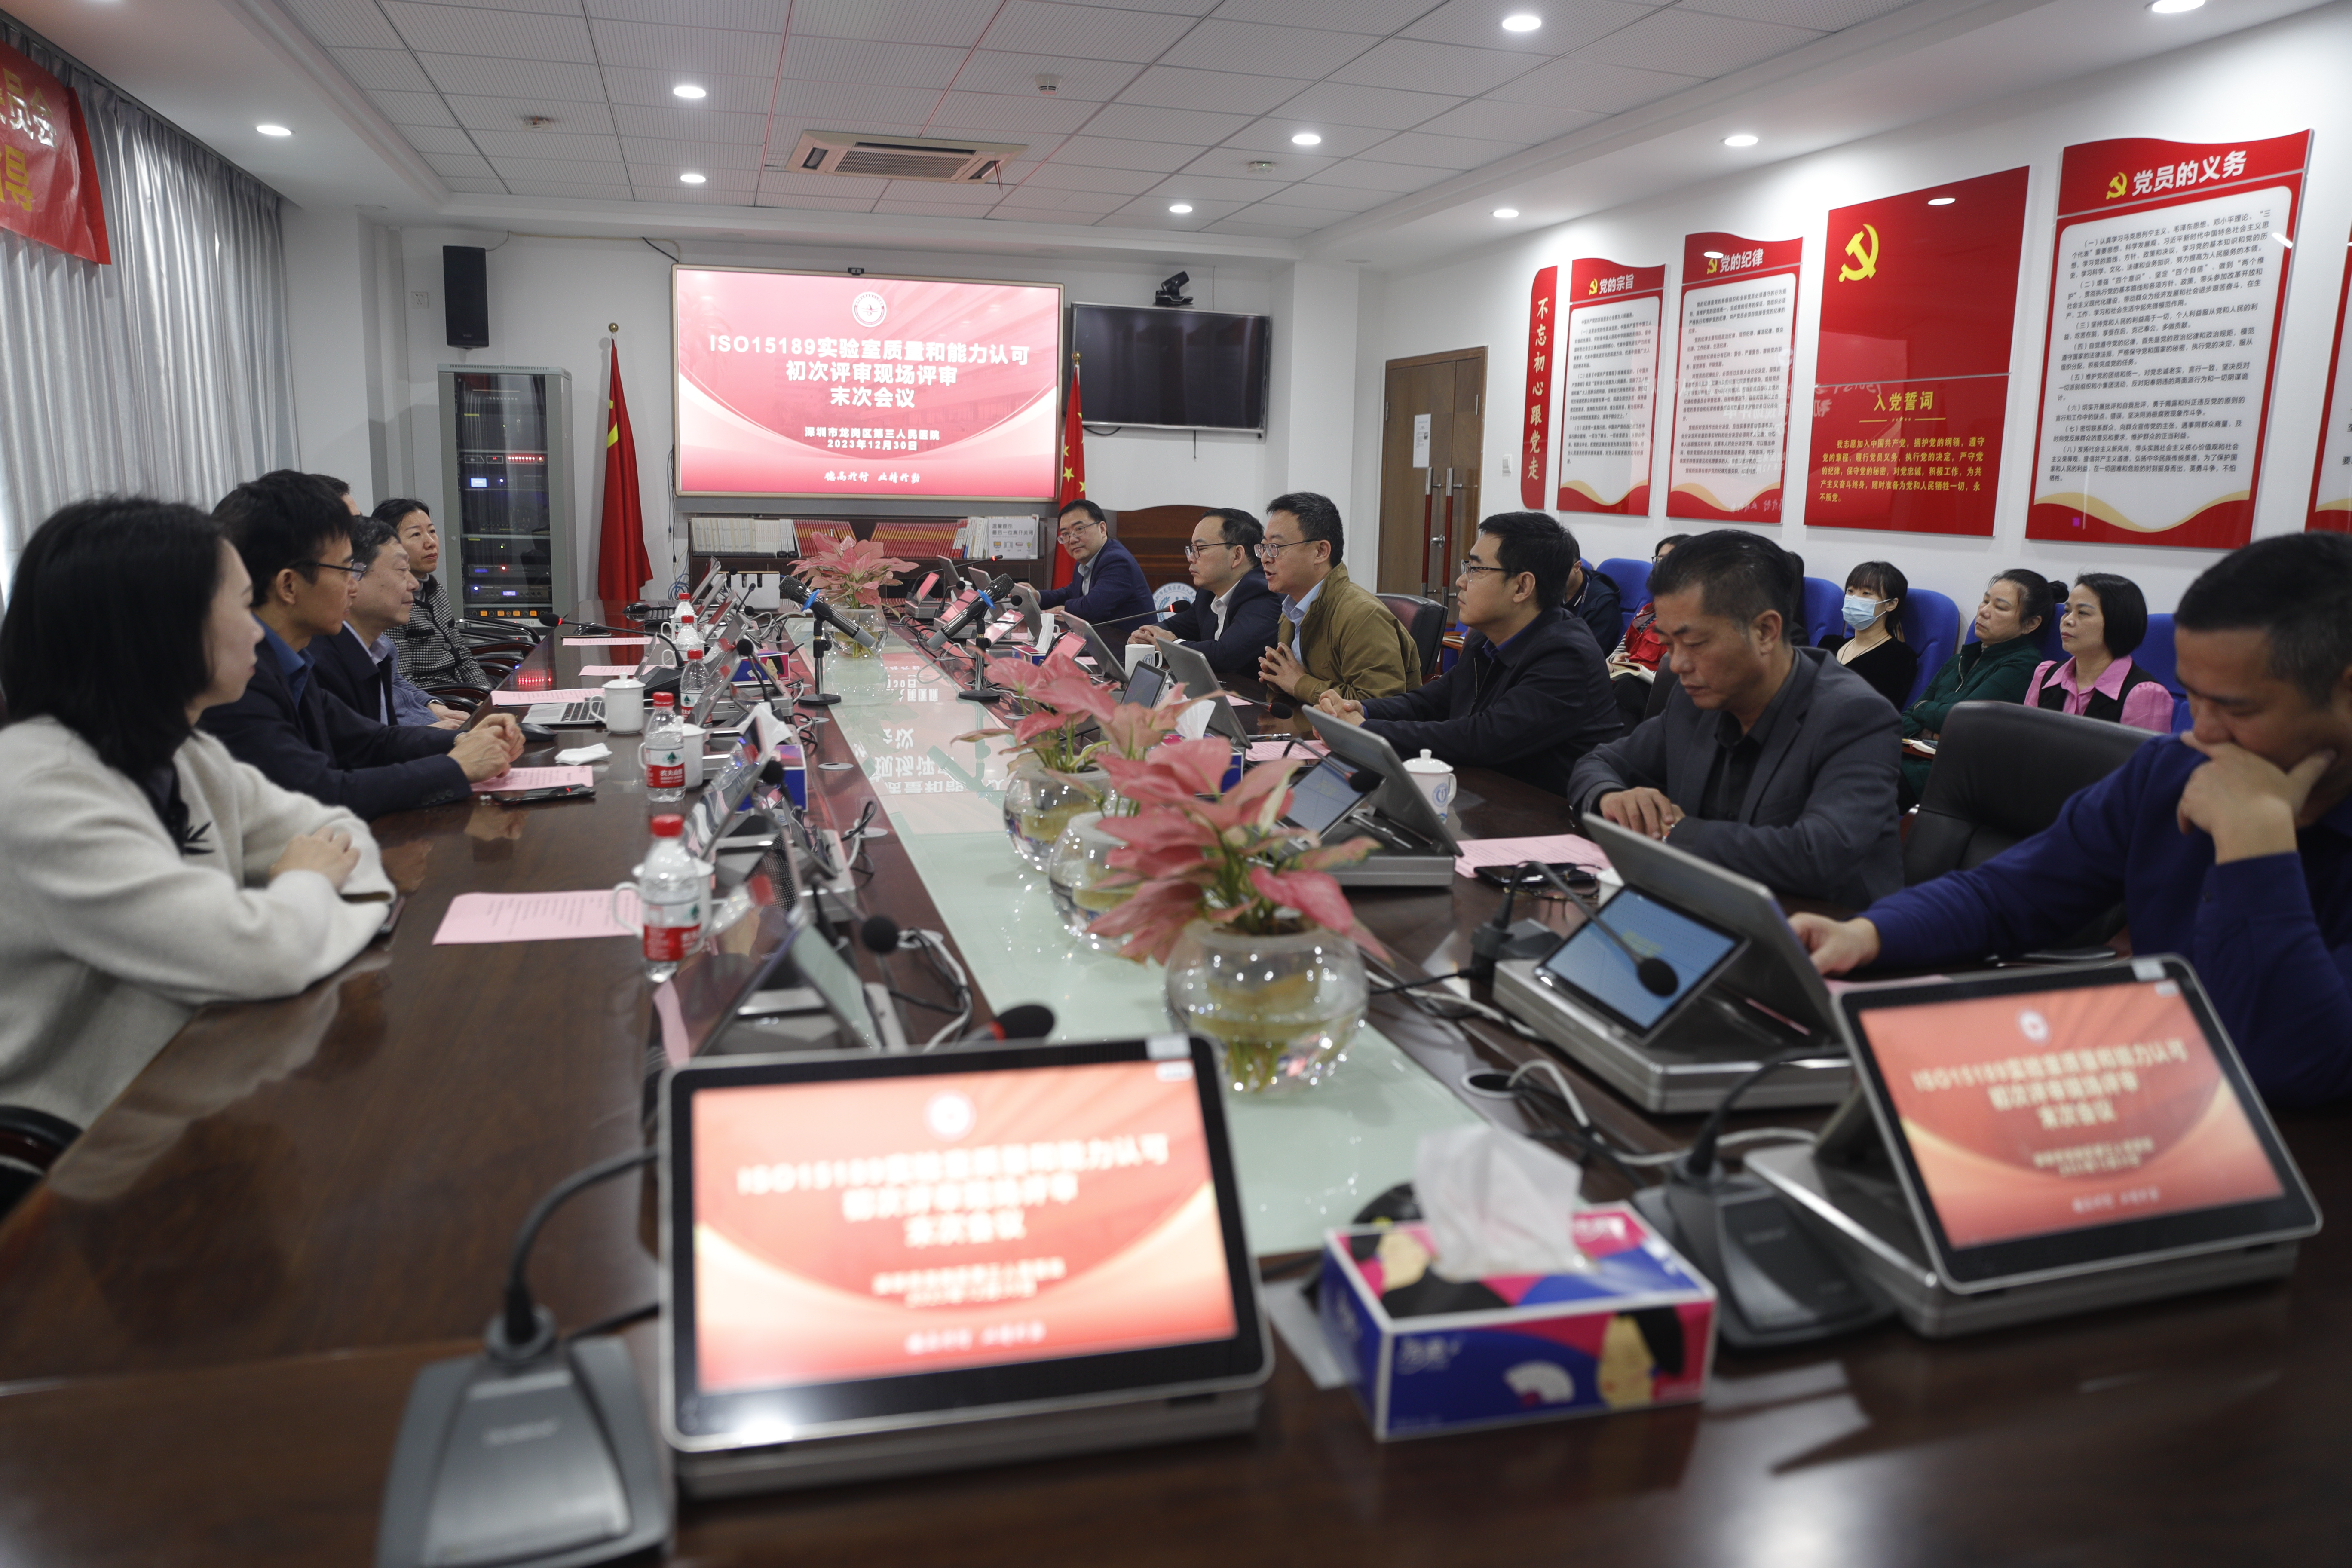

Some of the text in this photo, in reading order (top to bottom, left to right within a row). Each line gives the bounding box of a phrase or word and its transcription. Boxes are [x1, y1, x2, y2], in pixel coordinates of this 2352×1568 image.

[0, 68, 58, 148] 员会
[2132, 150, 2247, 196] 党员的义务
[1720, 248, 1764, 273] 党的纪律
[1599, 274, 1634, 294] 党的宗旨
[710, 335, 1029, 365] ISO15189实验室质量和能力认可
[786, 360, 957, 386] 初次评审现场评审
[830, 386, 915, 408] 末次会议
[1527, 297, 1548, 481] 不忘初心跟党走
[1874, 391, 1934, 411] 入党誓词
[805, 426, 940, 440] 深圳市龙岗区第三人民医院
[827, 439, 917, 451] 2023年12月30日
